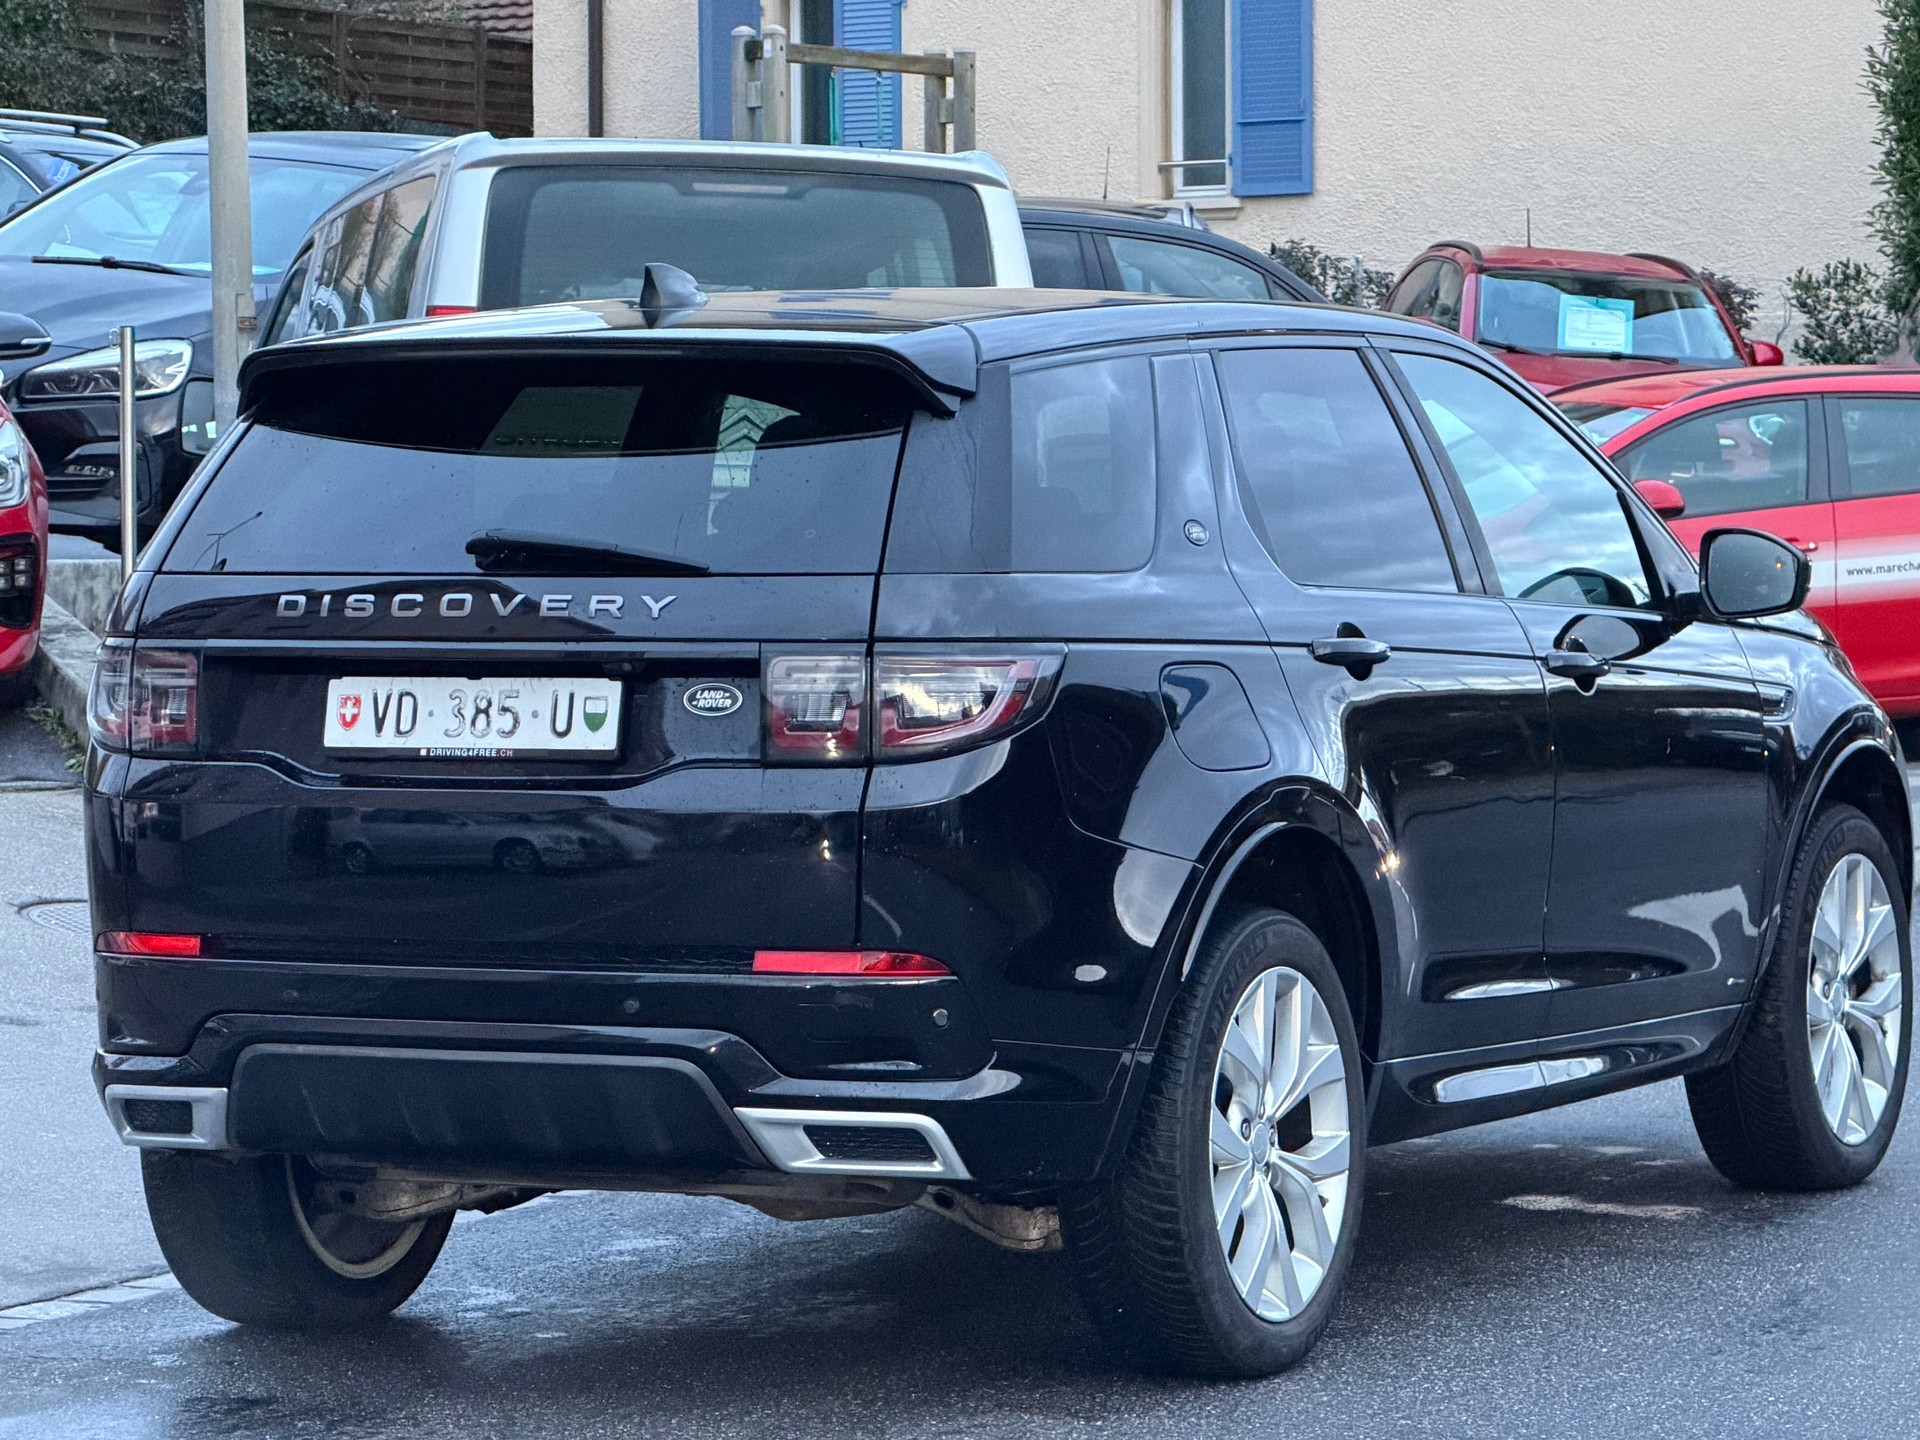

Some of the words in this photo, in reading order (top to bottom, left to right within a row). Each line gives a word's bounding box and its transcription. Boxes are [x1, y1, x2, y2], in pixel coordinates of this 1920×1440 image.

[276, 593, 678, 619] DISCOVERY
[696, 690, 724, 698] LAND
[697, 699, 732, 708] ROVER
[371, 688, 418, 738] VD
[442, 688, 521, 738] 385
[549, 690, 575, 739] U
[429, 748, 513, 757] DRIVING4FREE.CH
